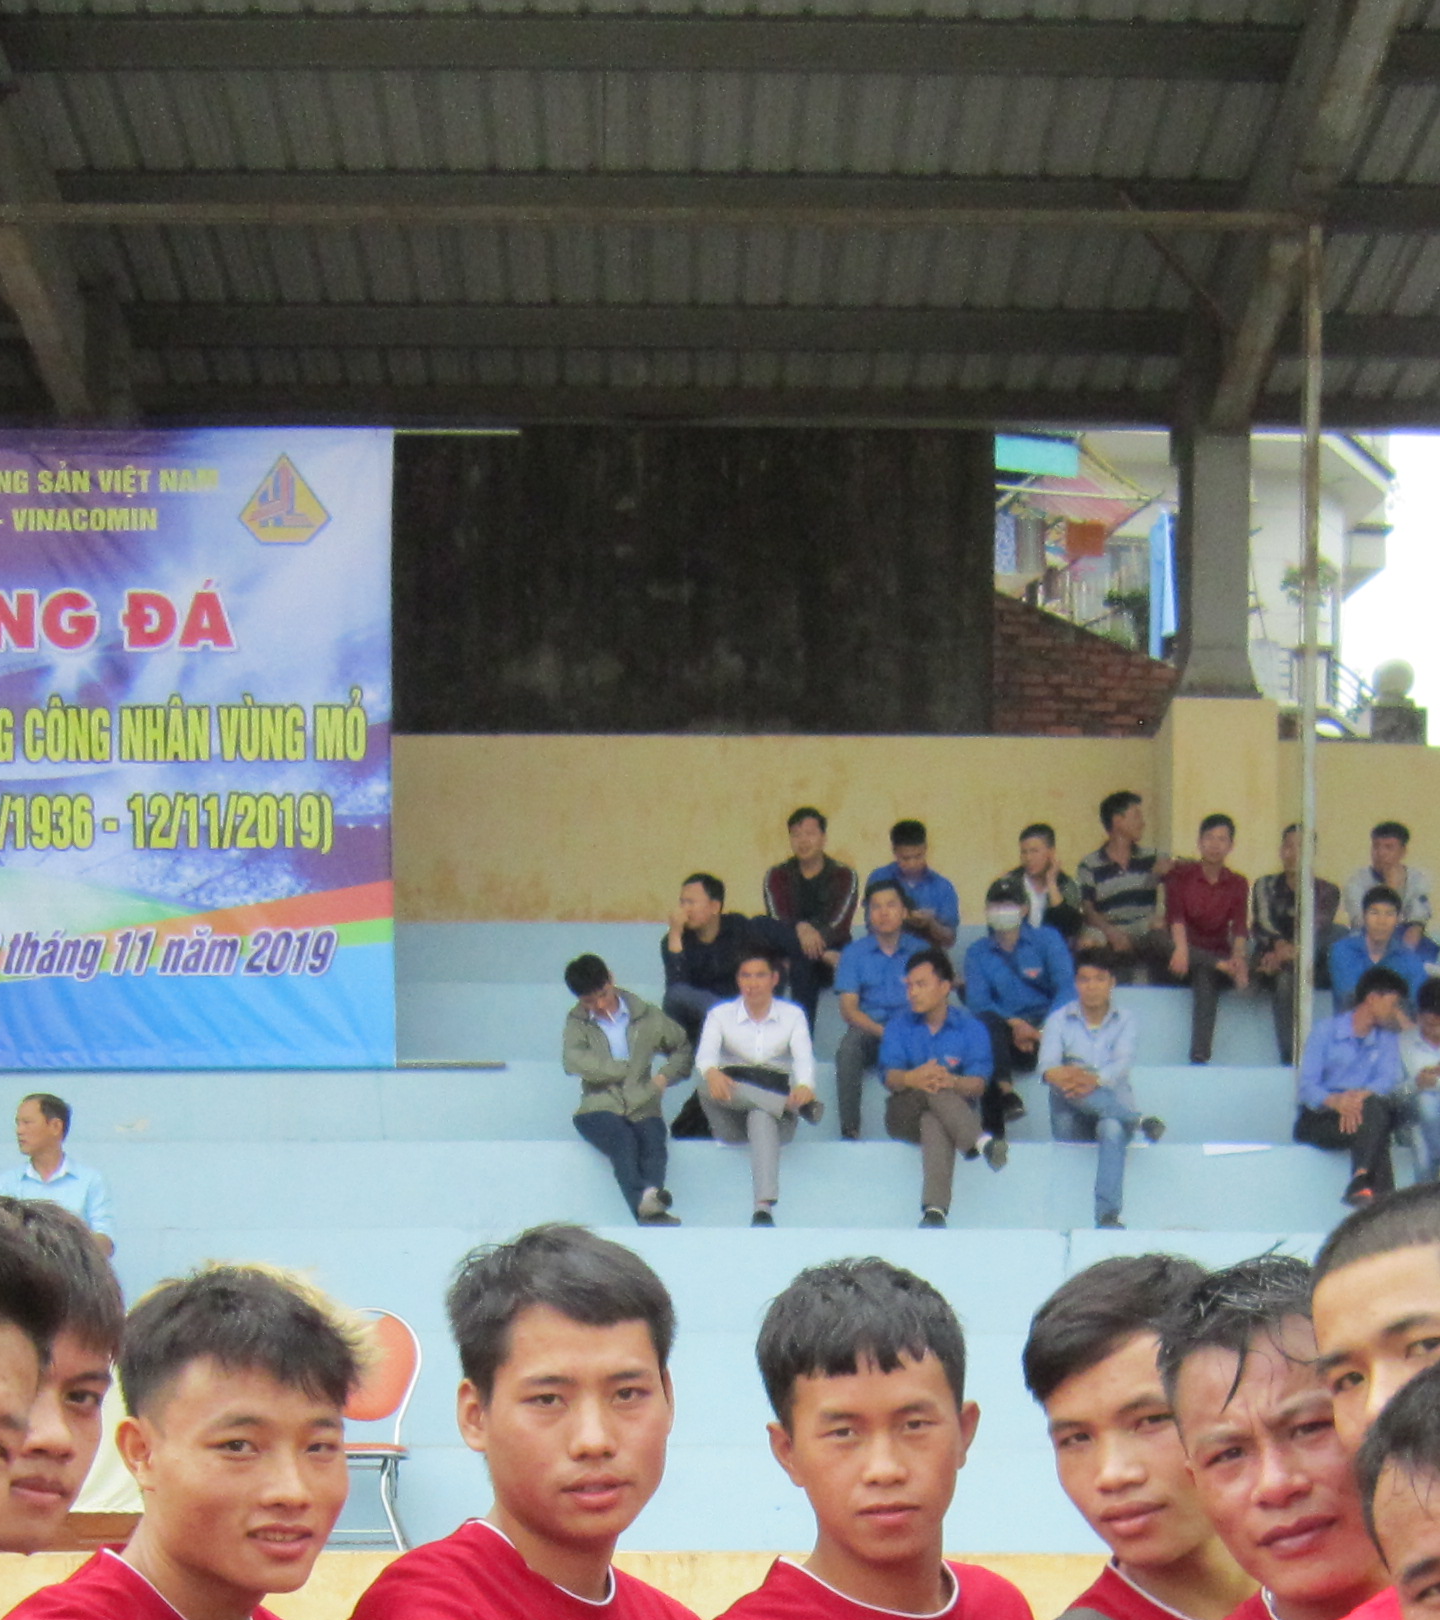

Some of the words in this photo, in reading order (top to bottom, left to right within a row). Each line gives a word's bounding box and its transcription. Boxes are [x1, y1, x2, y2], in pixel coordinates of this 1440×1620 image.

[37, 460, 90, 494] SẢN
[97, 465, 151, 498] VIỆT
[158, 468, 219, 493] NAM
[12, 507, 157, 532] VINACOMIN
[120, 578, 236, 653] ĐÁ
[24, 692, 111, 764] CÔNG
[120, 692, 210, 763] NHÂN
[217, 693, 306, 762] VÙNG
[315, 686, 368, 762] MỎ
[127, 791, 336, 855] 12/11/2019)
[2, 929, 104, 980] tháng
[112, 931, 158, 976] 11
[160, 927, 239, 976] năm
[243, 929, 337, 976] 2019
